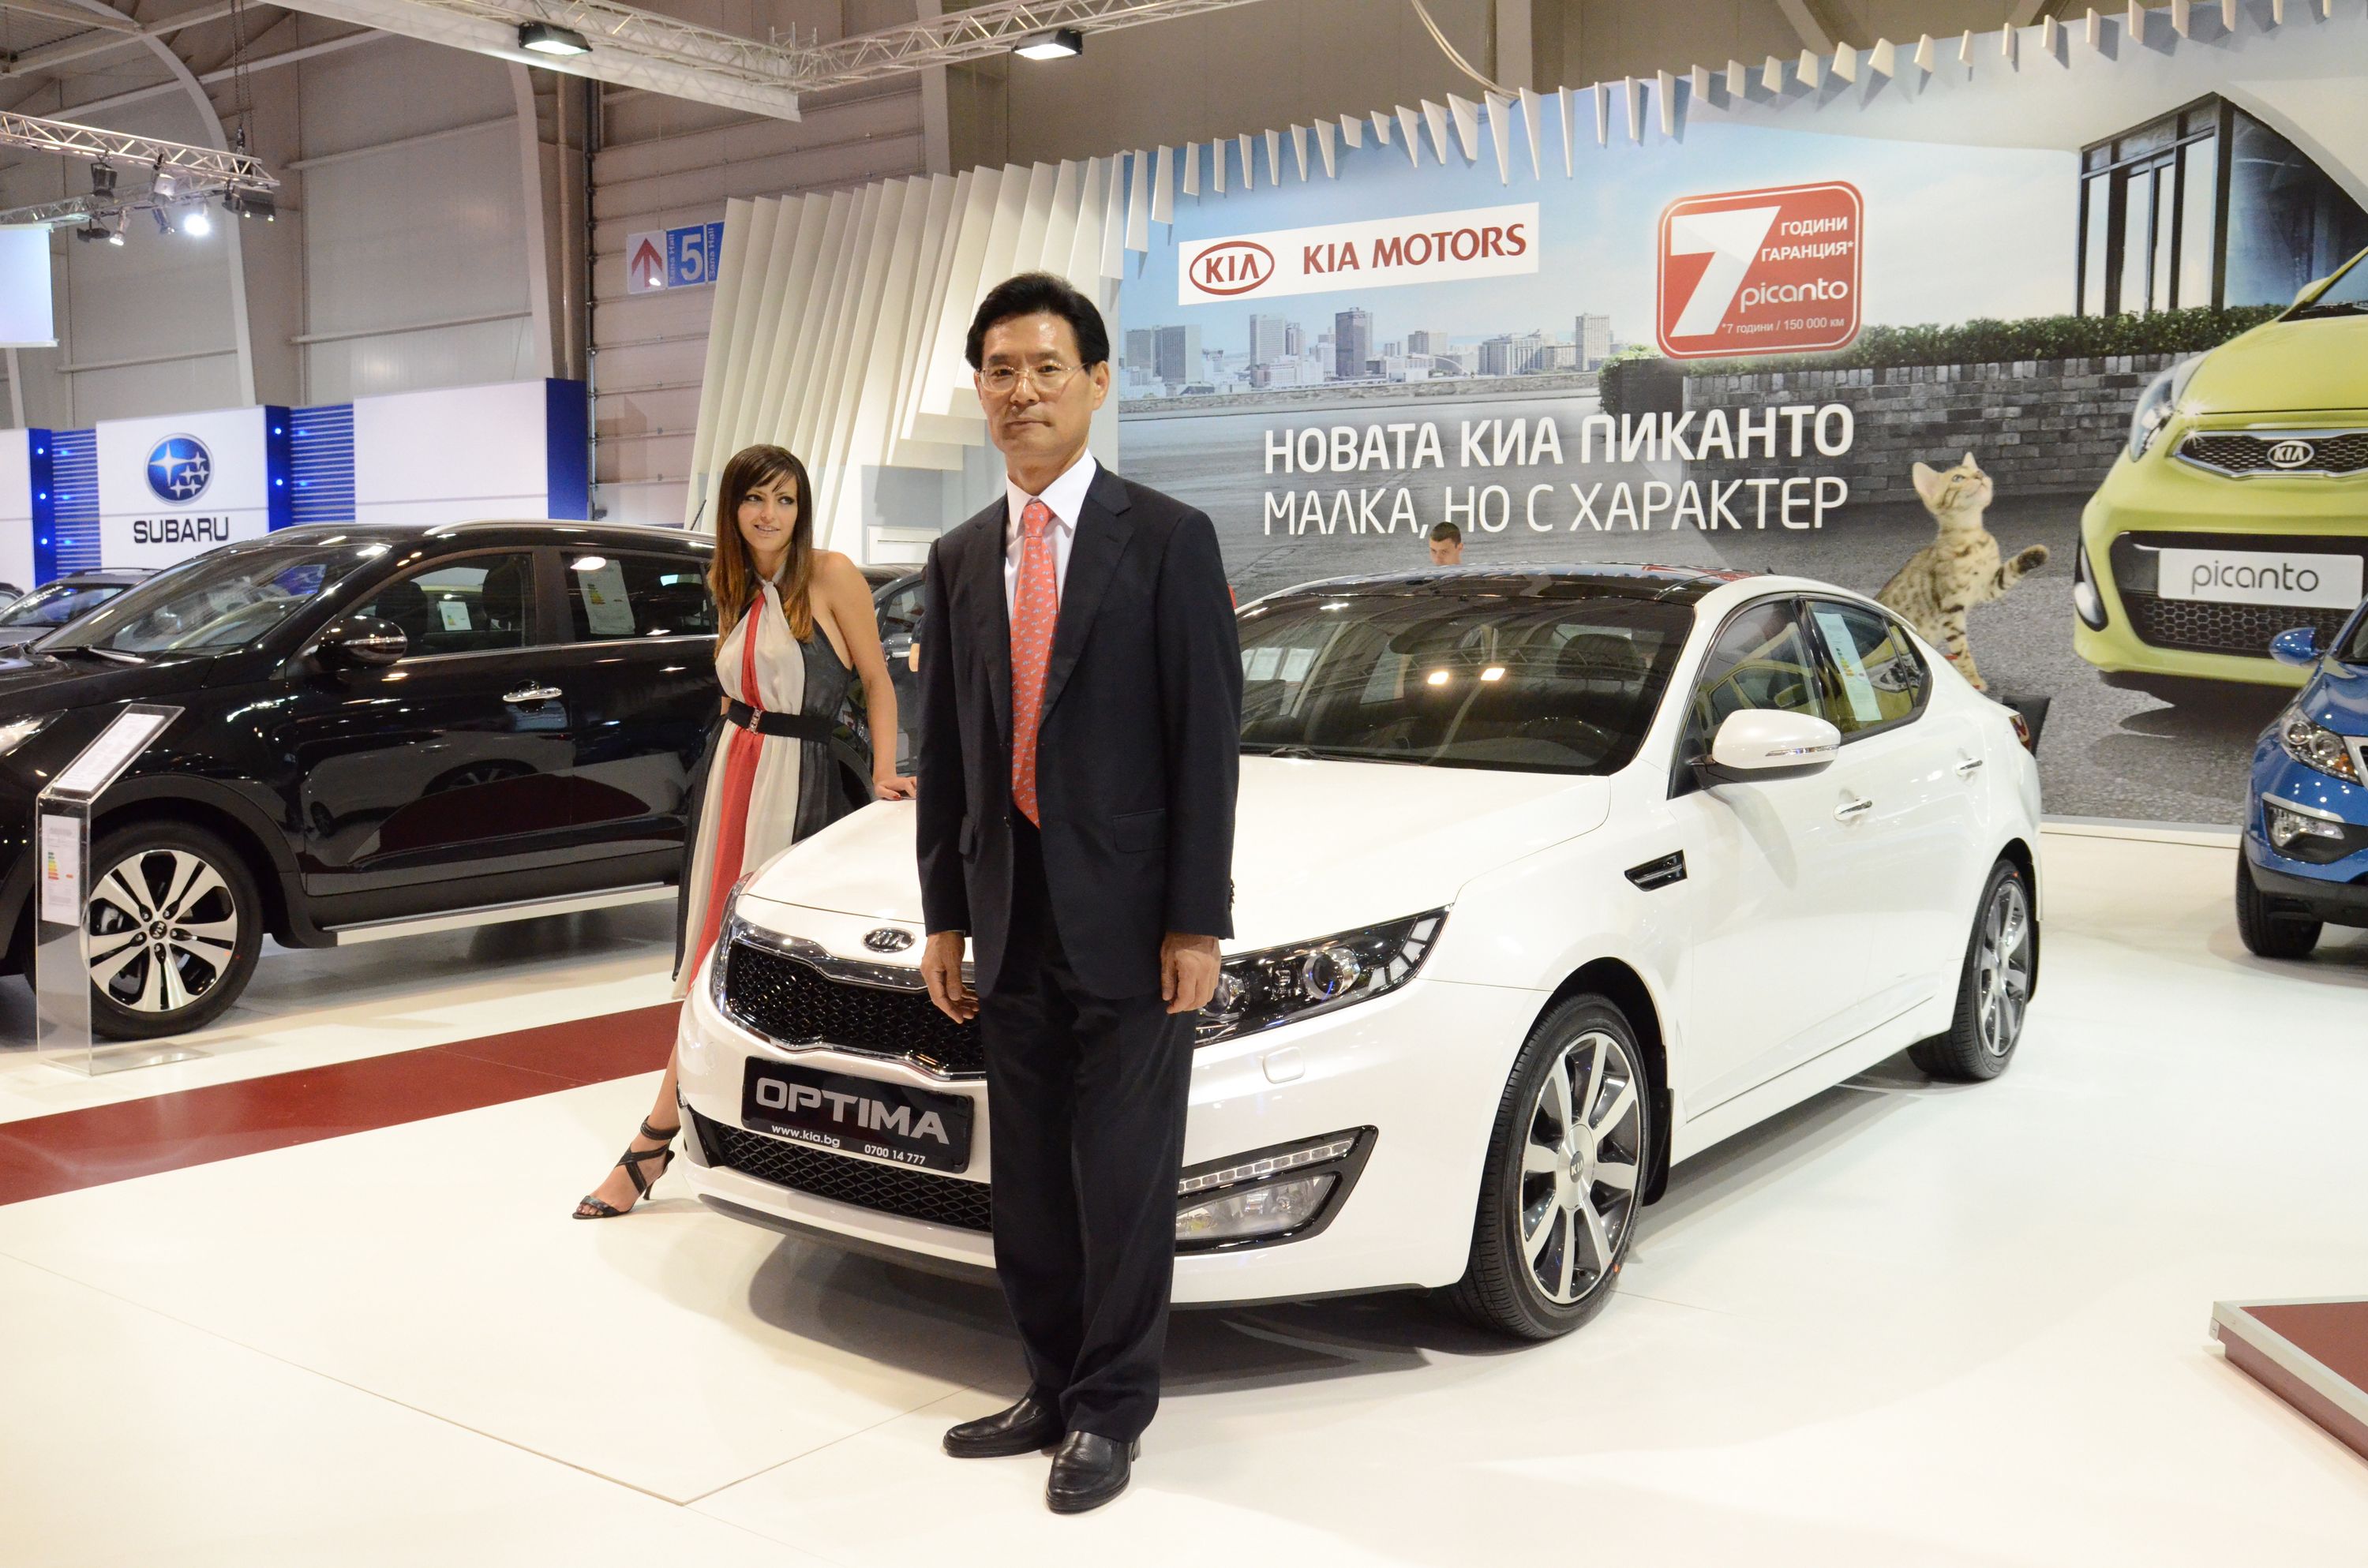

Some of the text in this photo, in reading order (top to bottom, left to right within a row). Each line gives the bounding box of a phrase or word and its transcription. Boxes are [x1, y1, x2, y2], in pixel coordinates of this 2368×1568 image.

[1780, 216, 1849, 237] ГОДИНИ
[680, 234, 703, 281] 5
[1303, 223, 1527, 275] KIA MOTORS
[1205, 253, 1261, 284] KIA
[1669, 205, 1782, 338] 7
[1740, 278, 1849, 313] picanto
[1736, 323, 1774, 335] години
[1784, 319, 1804, 331] 150
[1806, 317, 1828, 329] 000
[1830, 318, 1845, 327] км
[1265, 403, 1854, 473] НОВАТА КИА ПИКАНТО
[2273, 447, 2305, 461] KIA
[1264, 476, 1849, 540] МАЛКА, НО С ХАРАКТЕР
[133, 517, 229, 544] SUBARU
[2191, 559, 2319, 596] picanto
[755, 1077, 950, 1145] OPTIMA
[771, 1124, 841, 1149] www.kia.bg
[864, 1144, 926, 1166] 0700 14 777
[1571, 1159, 1583, 1176] KIA
